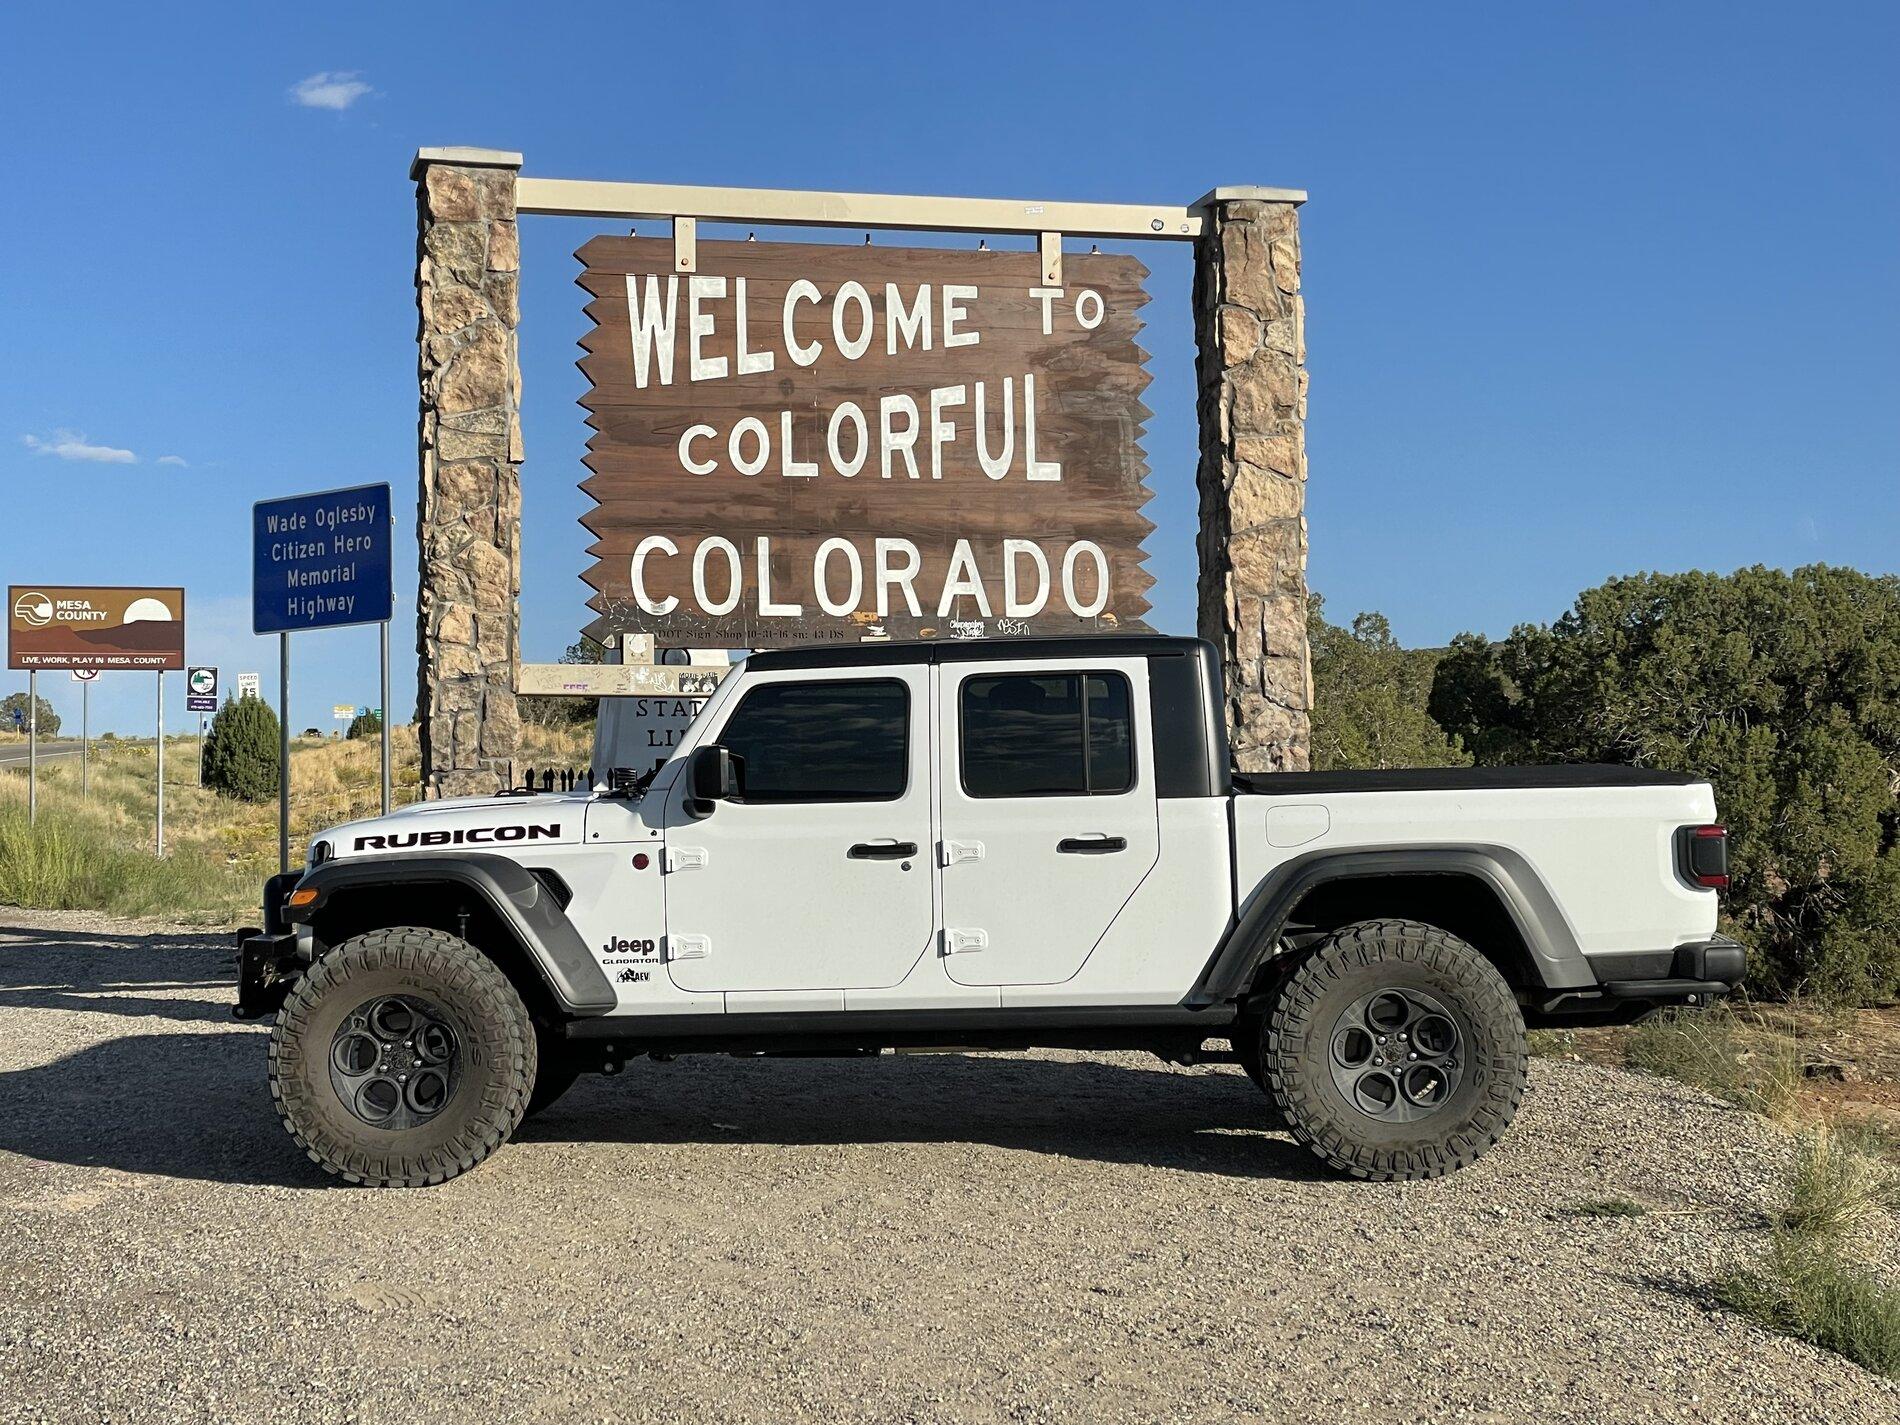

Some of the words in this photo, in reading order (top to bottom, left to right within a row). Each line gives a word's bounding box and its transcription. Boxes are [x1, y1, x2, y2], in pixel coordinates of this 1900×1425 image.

[625, 273, 980, 389] WELCOME
[1028, 288, 1106, 335] TO
[677, 373, 1062, 482] COLORFUL
[267, 513, 307, 534] Wade
[315, 502, 376, 532] Oglesby
[271, 541, 325, 562] Citizen
[334, 534, 372, 554] Hero
[287, 562, 355, 588] Memorial
[629, 535, 1110, 618] COLORADO
[56, 600, 92, 610] MESA
[56, 611, 108, 621] COUNTY
[288, 595, 355, 620] Highway
[686, 629, 711, 640] Sign
[716, 629, 742, 640] Shop
[22, 656, 41, 665] LIVE,
[42, 656, 70, 665] WORK,
[72, 656, 94, 665] PLAY
[95, 656, 104, 665] IN
[107, 656, 131, 665] MESA
[133, 656, 167, 665] COUNTY
[636, 699, 702, 718] STAT
[353, 824, 561, 851] RUBICON
[603, 936, 655, 955] Jeep
[635, 972, 650, 981] AEV
